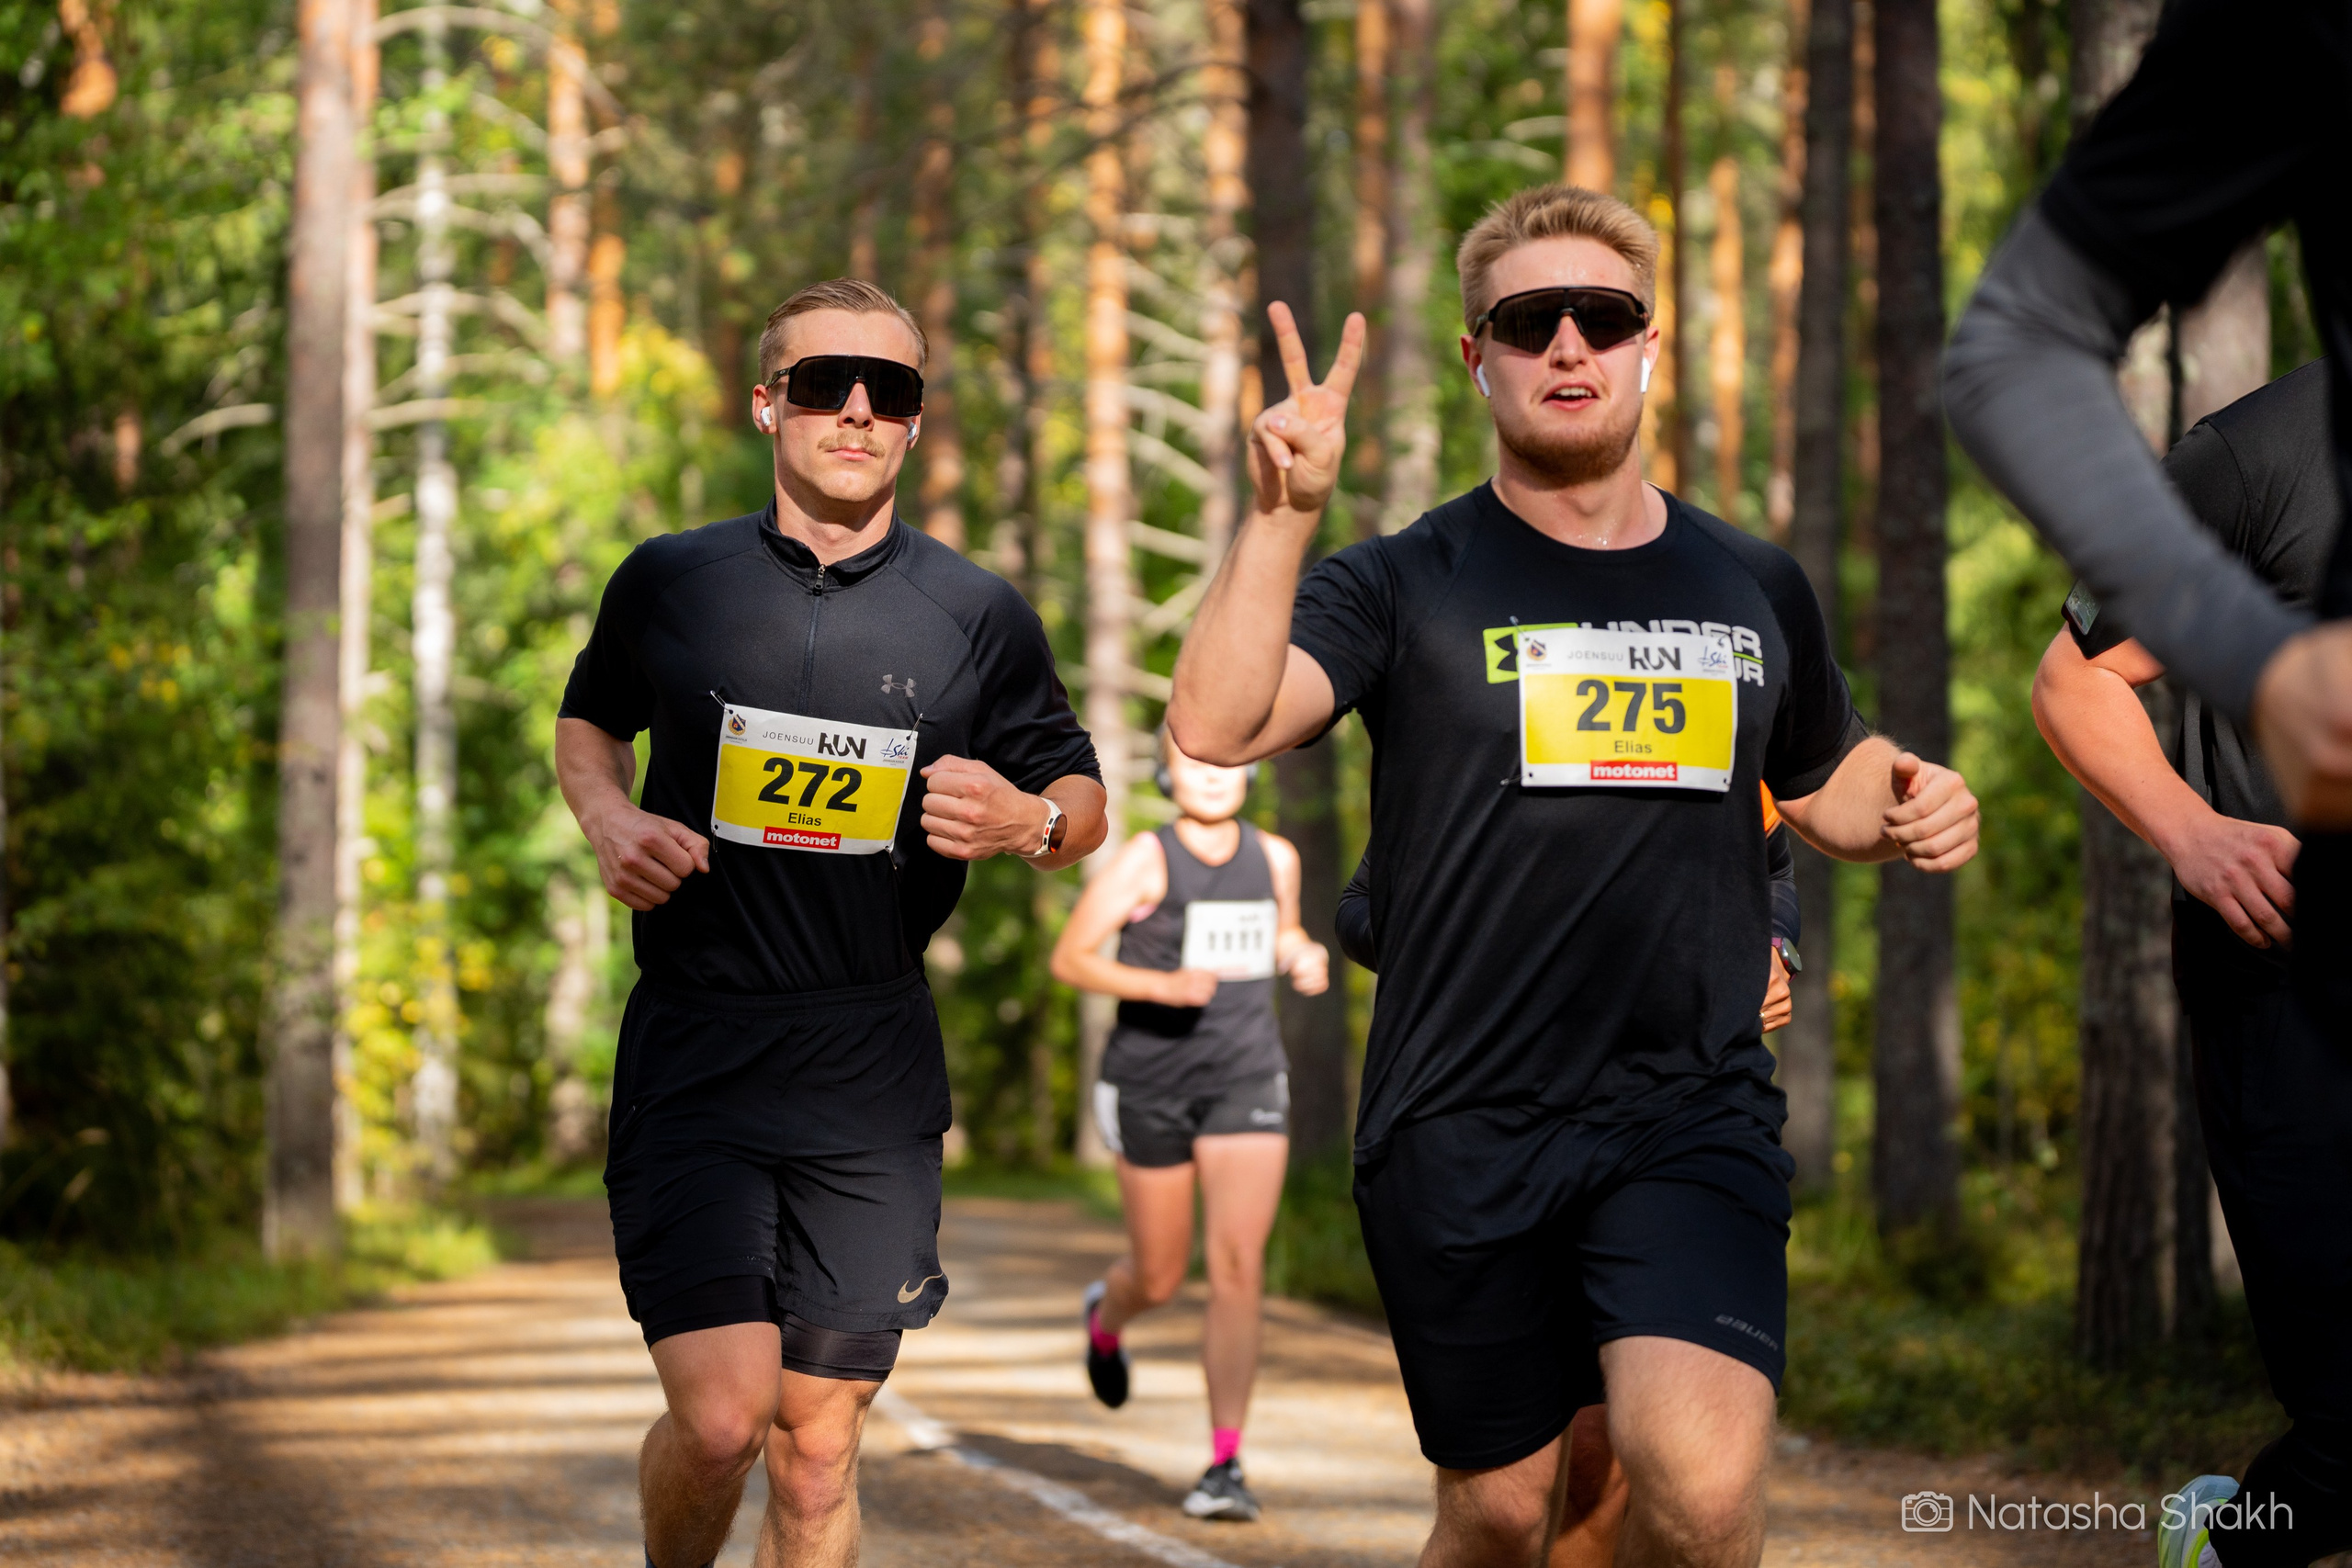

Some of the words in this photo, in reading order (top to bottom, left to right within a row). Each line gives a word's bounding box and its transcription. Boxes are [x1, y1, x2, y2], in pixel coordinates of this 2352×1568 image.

[1580, 619, 1762, 659] DER
[1567, 649, 1624, 662] JOENSUU
[1628, 646, 1682, 671] RUN
[1575, 679, 1686, 735] 275
[763, 731, 814, 746] JOENSUU
[818, 732, 866, 760] RUN
[889, 744, 910, 759] Ski
[1613, 739, 1653, 754] Elias
[1592, 764, 1676, 779] motonet
[757, 757, 863, 813] 272
[787, 812, 822, 827] Elias
[766, 831, 837, 847] motonet
